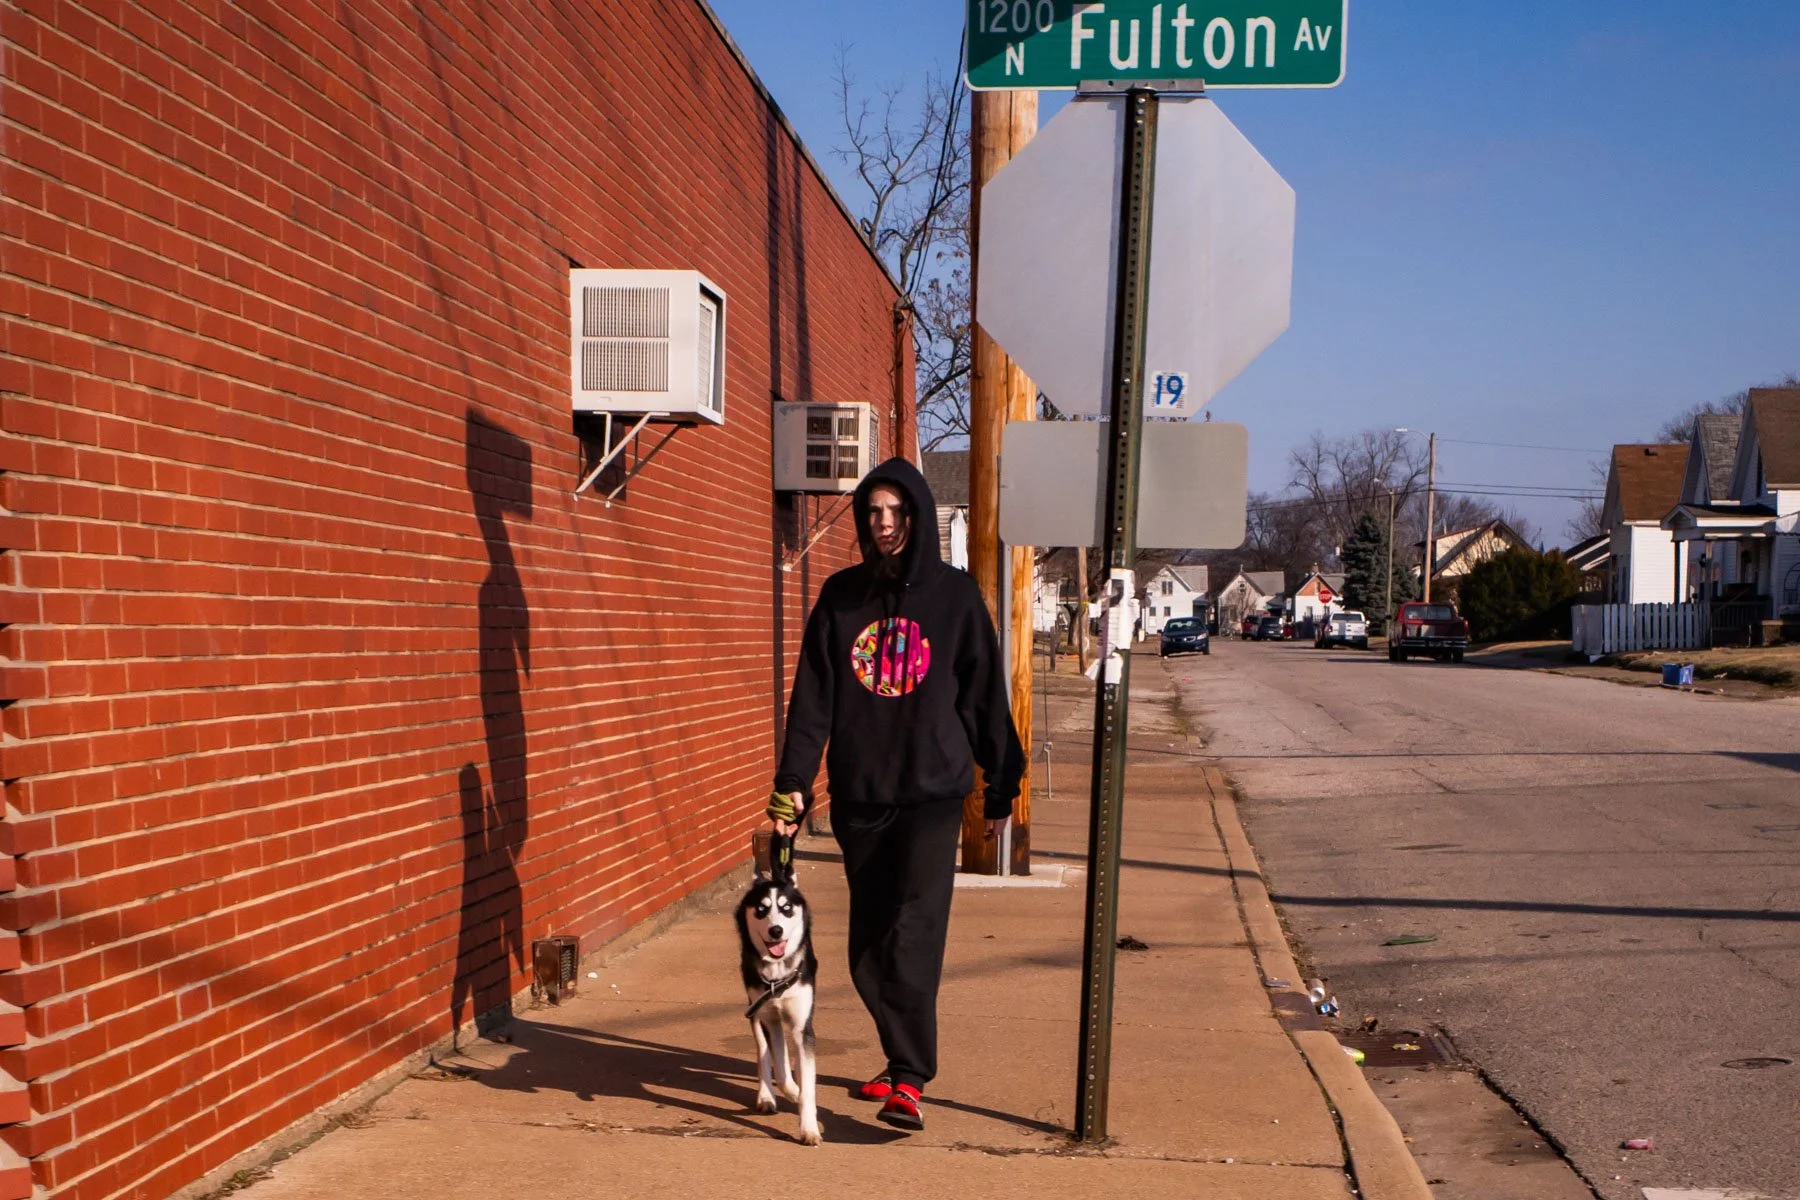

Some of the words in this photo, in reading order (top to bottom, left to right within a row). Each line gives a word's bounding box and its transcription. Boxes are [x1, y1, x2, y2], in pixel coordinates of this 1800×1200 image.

[979, 0, 1054, 33] 1200
[1070, 2, 1276, 71] Fulton
[1293, 17, 1332, 51] Av
[1005, 41, 1025, 76] N
[1156, 375, 1183, 405] 19
